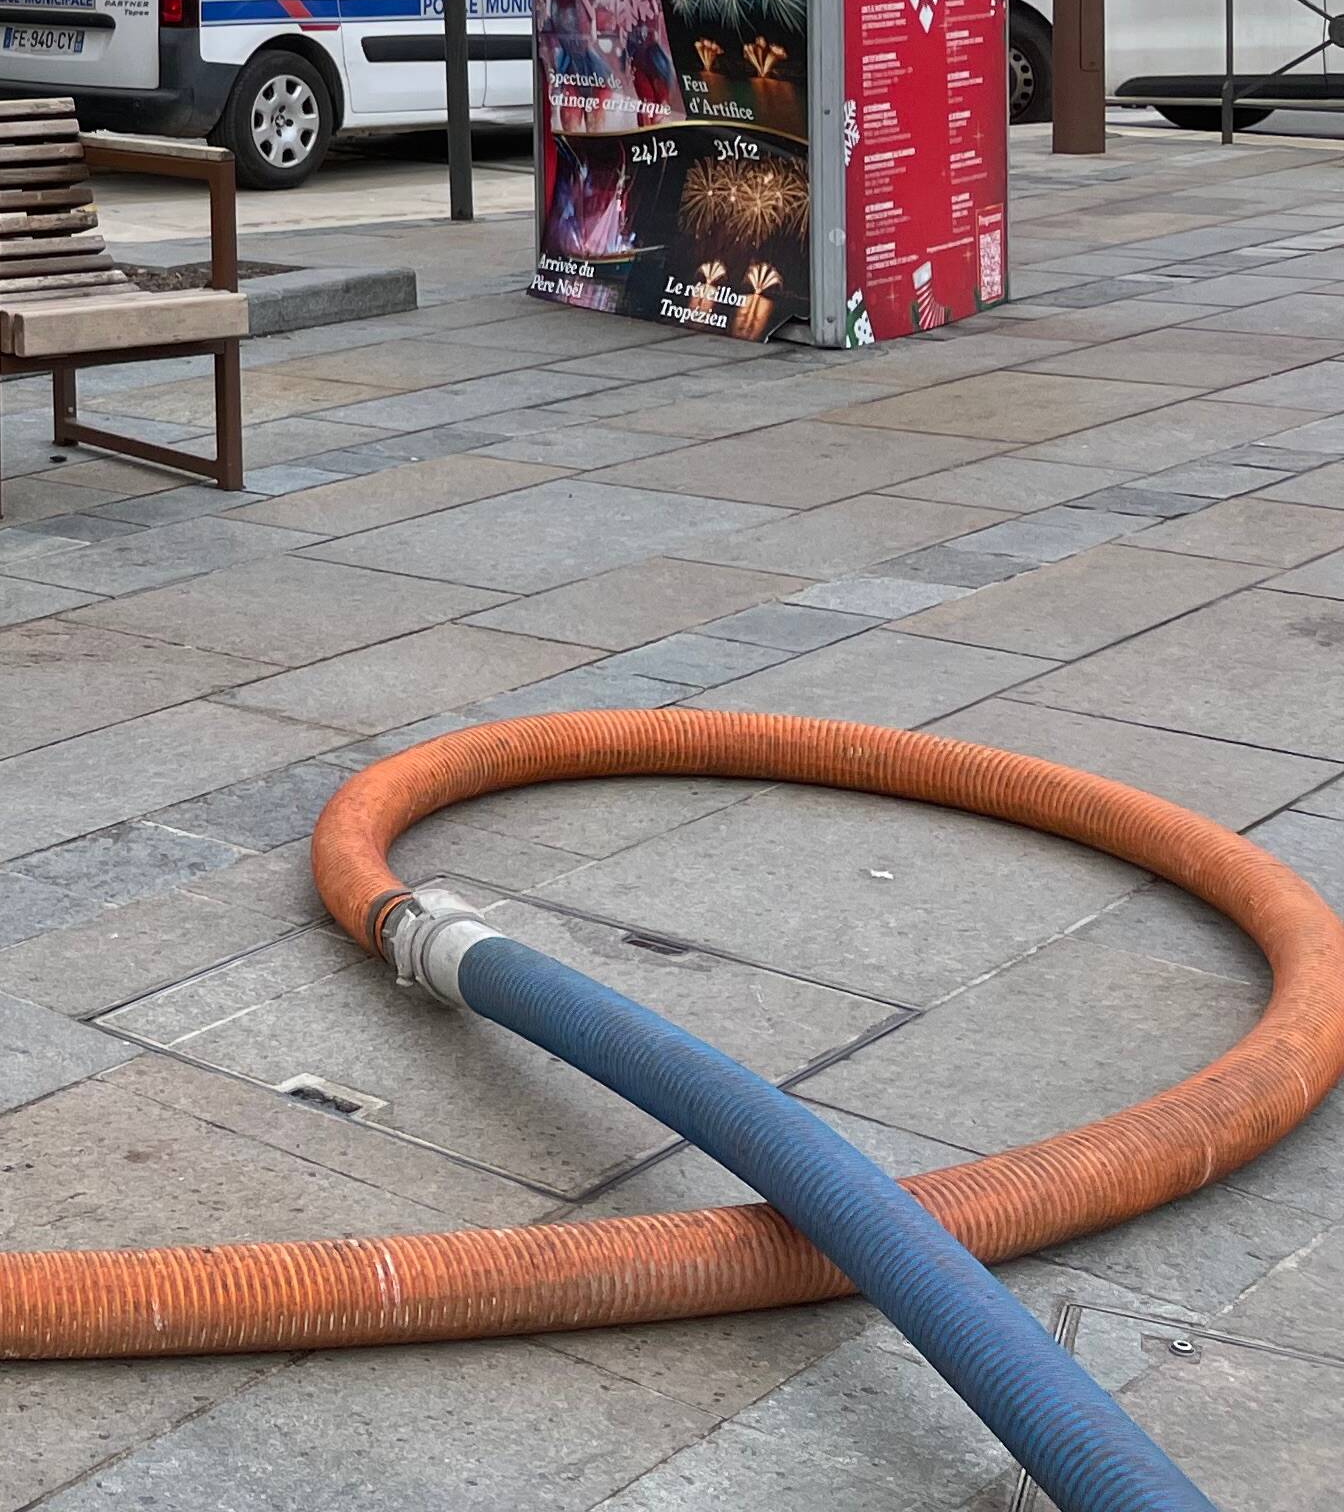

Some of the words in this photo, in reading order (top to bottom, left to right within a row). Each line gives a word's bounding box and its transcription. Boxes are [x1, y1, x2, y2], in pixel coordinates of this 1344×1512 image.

[104, 0, 150, 8] PARTNER
[607, 72, 623, 89] de
[682, 74, 709, 93] Feu
[548, 91, 600, 113] atinage
[602, 96, 672, 119] artistique
[631, 135, 679, 165] 24/12
[713, 135, 761, 161] 31/12
[538, 253, 578, 277] Arrivée
[578, 258, 595, 279] du
[530, 275, 556, 294] Père
[555, 279, 584, 299] Noël
[664, 275, 684, 296] Le
[684, 281, 748, 307] réveillon
[659, 298, 728, 328] Tropézien
